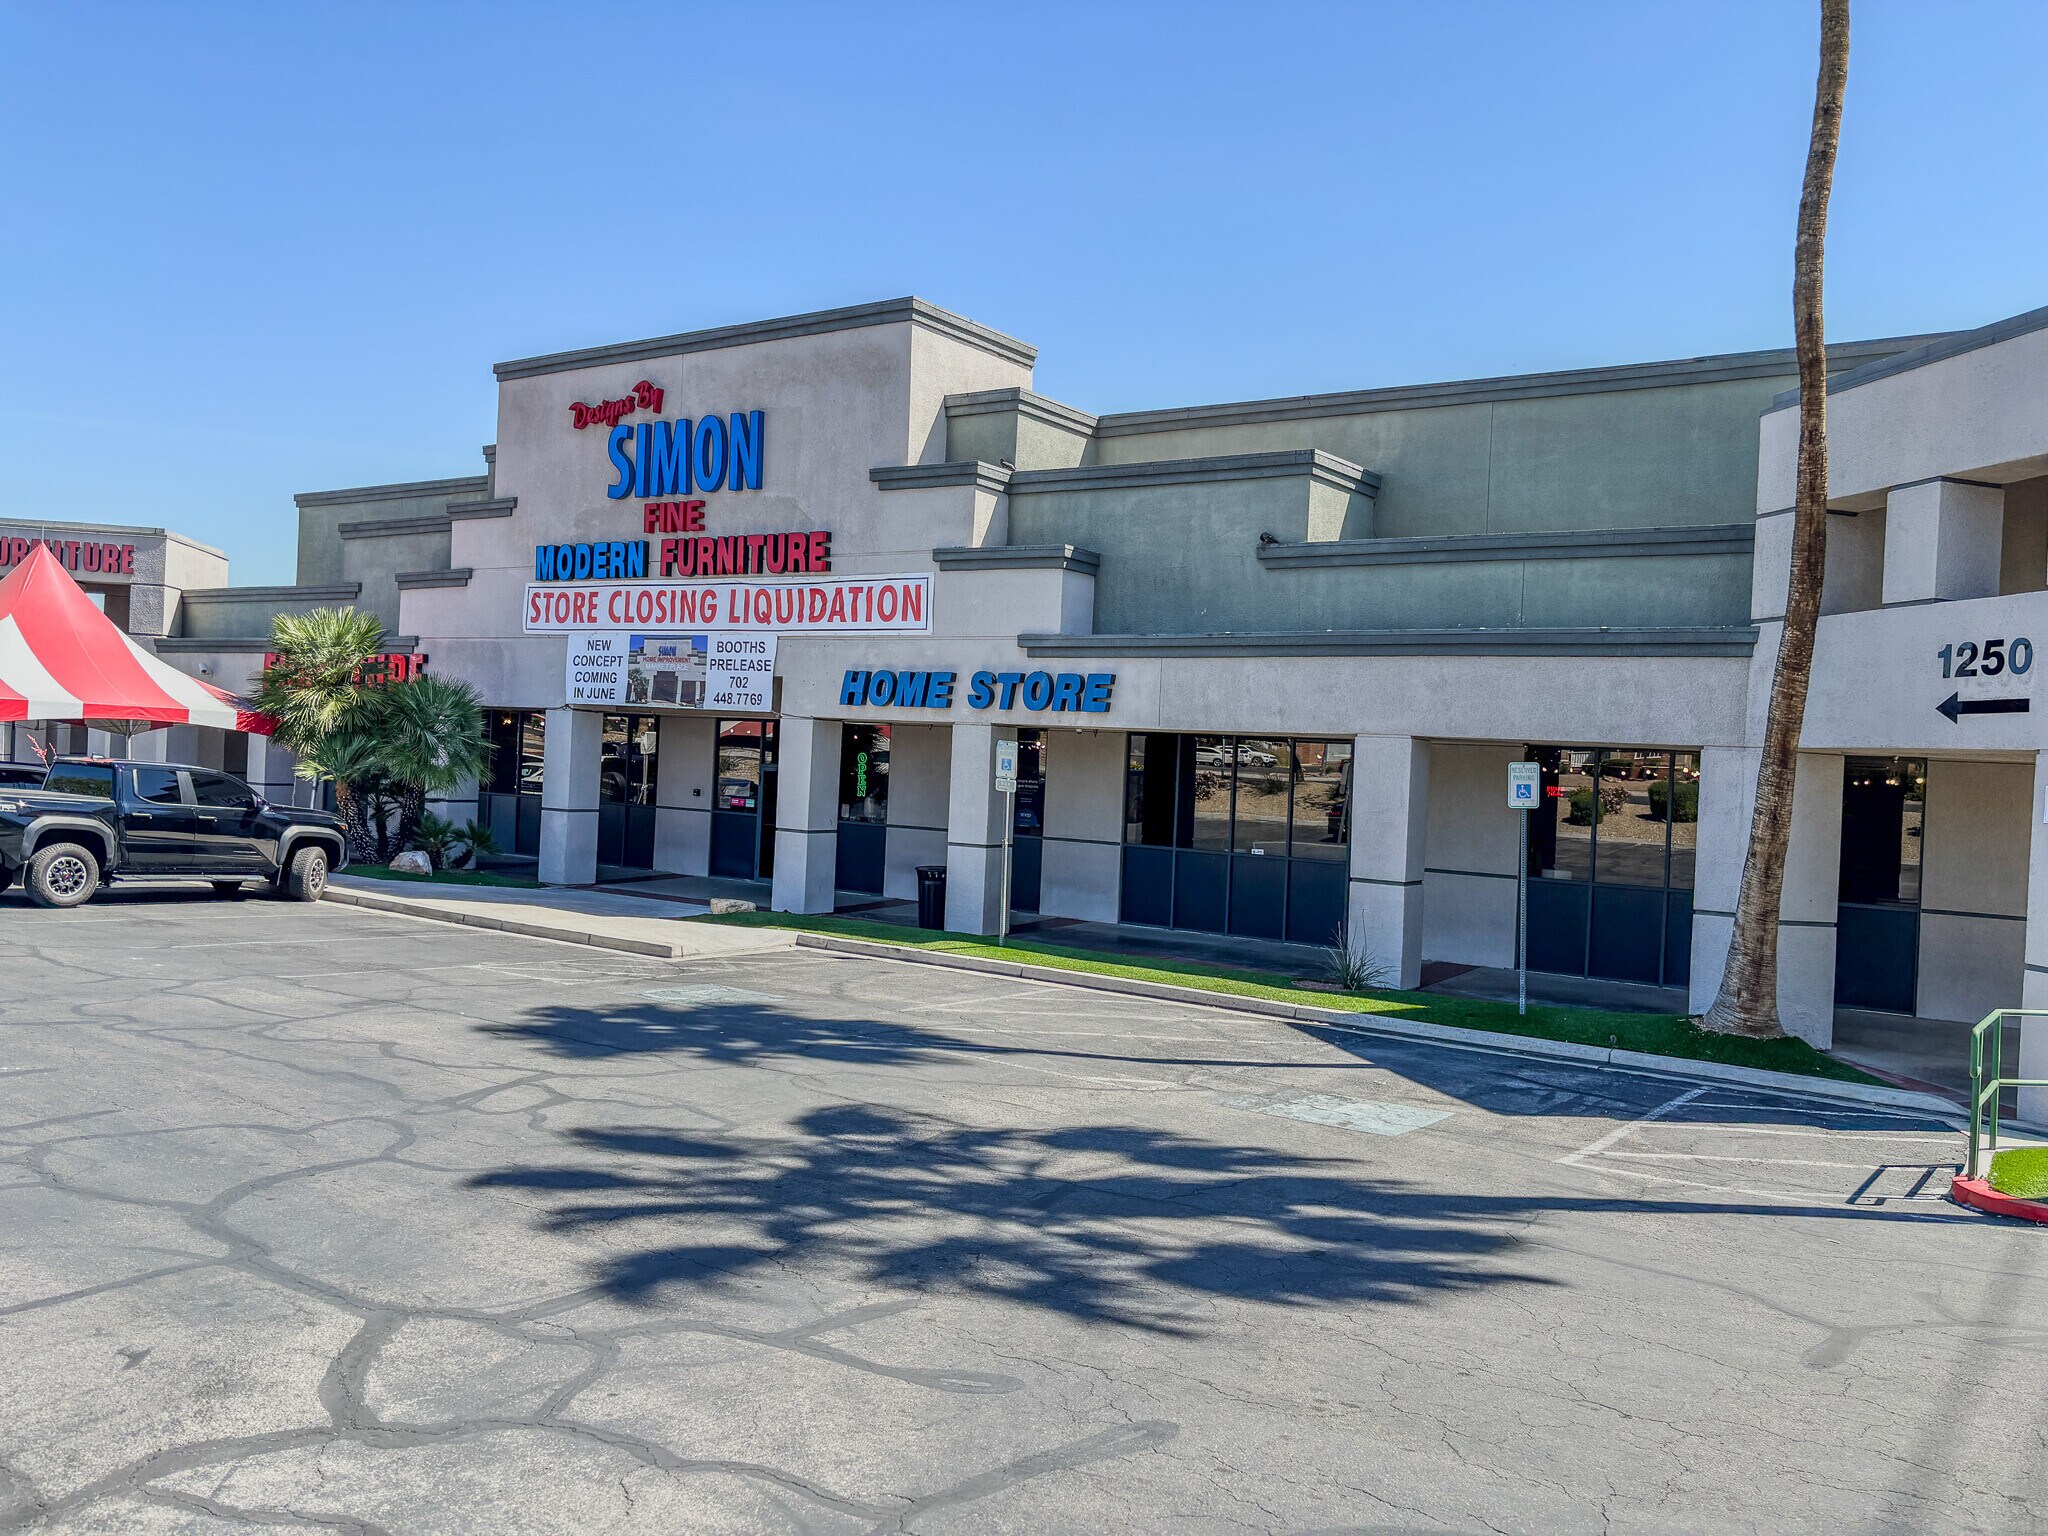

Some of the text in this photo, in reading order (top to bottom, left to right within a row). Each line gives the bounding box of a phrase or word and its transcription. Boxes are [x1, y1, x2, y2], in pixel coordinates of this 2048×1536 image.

[568, 380, 664, 430] Designs By
[607, 410, 765, 499] SIMON
[644, 500, 706, 533] FINE
[535, 531, 832, 581] MODERN FURNITURE
[530, 584, 922, 626] STORE CLOSING LIQUIDATION
[587, 639, 612, 651] NEW
[716, 640, 766, 654] BOOTHS
[572, 654, 624, 667] CONCEPT
[709, 658, 772, 672] PRELEASE
[1937, 637, 2033, 679] 1250
[645, 662, 689, 671] MARKET PLACE
[574, 671, 618, 684] COMING
[729, 676, 749, 689] 702
[573, 687, 616, 700] IN JUNE
[839, 669, 1116, 712] HOME STORE
[713, 692, 763, 706] 448.7769
[856, 752, 868, 797] OPEN
